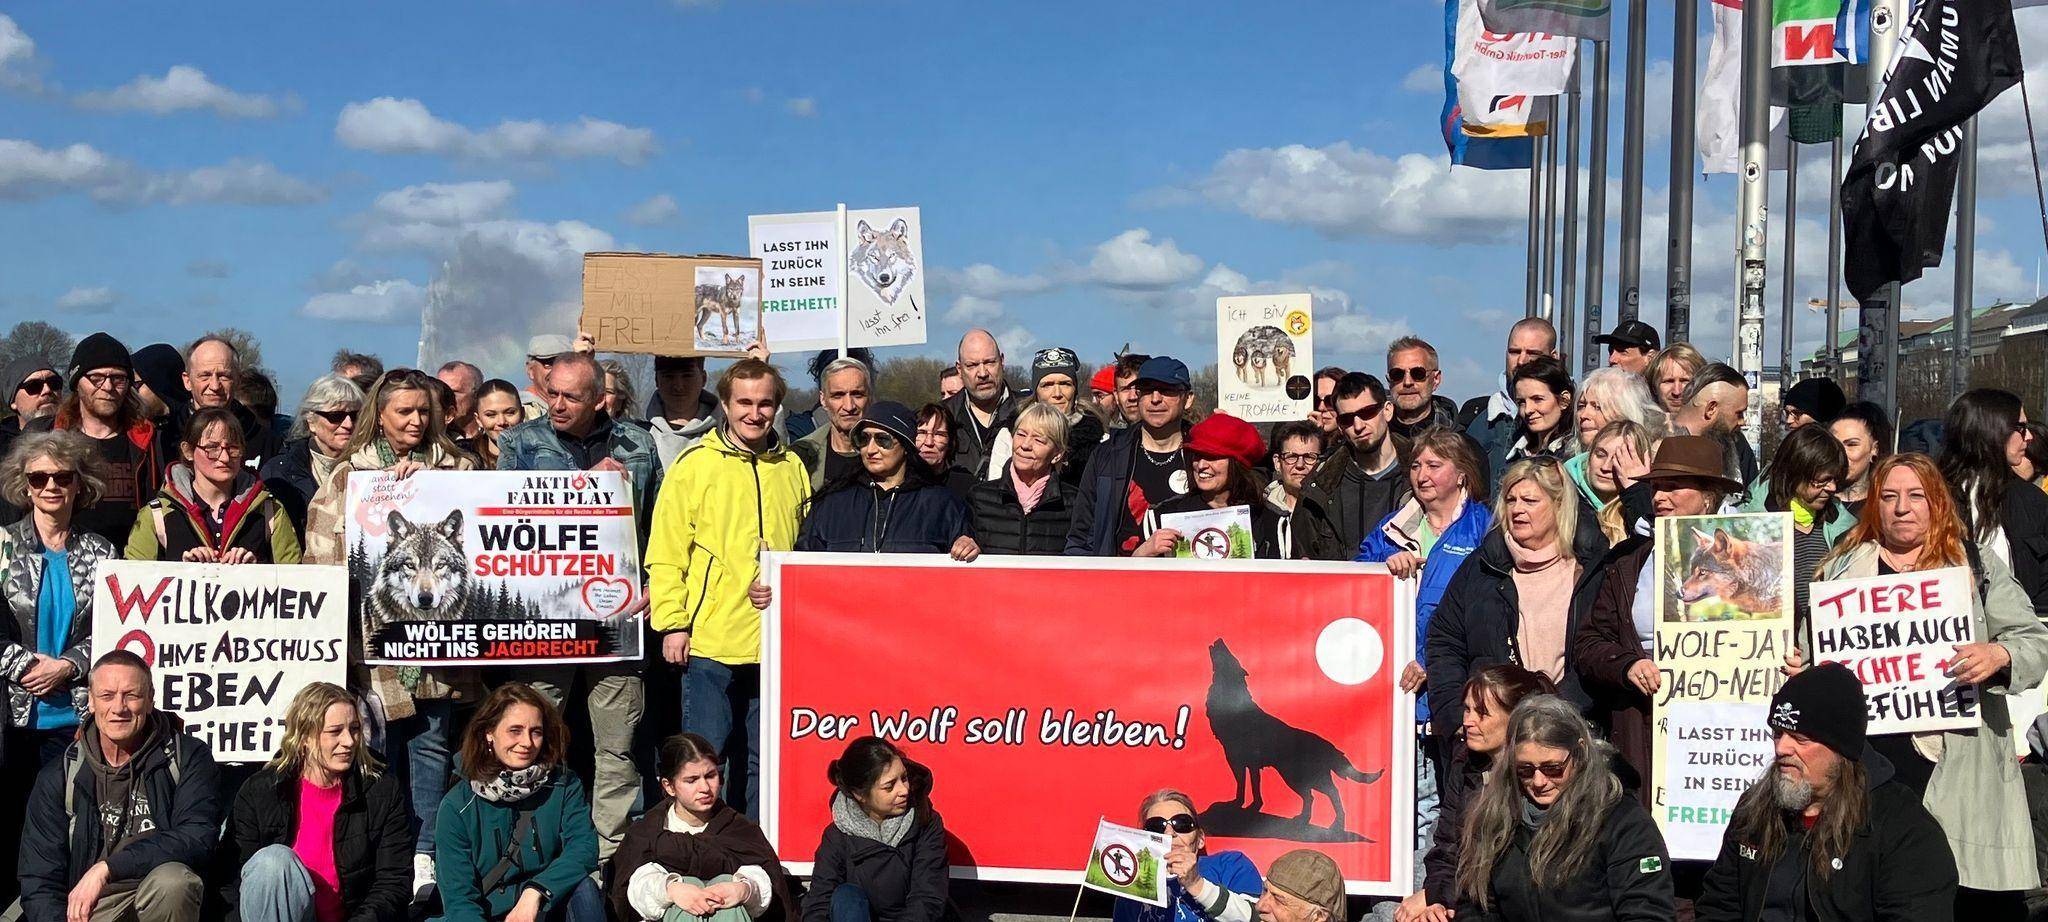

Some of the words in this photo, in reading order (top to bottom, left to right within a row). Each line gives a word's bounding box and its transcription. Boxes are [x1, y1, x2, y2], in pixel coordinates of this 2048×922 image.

[763, 240, 801, 252] LASST
[805, 240, 829, 251] IHN
[772, 256, 823, 270] ZURÜCK
[770, 278, 785, 288] IN
[789, 276, 826, 287] SEINE
[762, 297, 837, 312] FREIHEIT!
[1225, 393, 1251, 401] KEINE
[372, 484, 396, 493] statt
[507, 491, 555, 505] FAIR
[563, 491, 615, 505] PLAY
[478, 518, 599, 551] WÖLFE
[475, 551, 614, 577] SCHÜTZEN
[1818, 579, 1942, 618] TIERE
[405, 620, 477, 641] WÖLFE
[482, 619, 577, 641] GEHÖREN
[1818, 620, 1901, 653] HABEN
[1906, 615, 1971, 647] AUCH
[211, 630, 343, 664] ABSCHUSS
[384, 642, 441, 658] NICHT
[446, 642, 479, 658] INS
[484, 640, 599, 658] JAGDRECHT
[162, 671, 284, 713] EBEN
[1864, 684, 1977, 721] EFÜHLE
[790, 706, 859, 740] Der
[869, 706, 959, 745] Wolf
[964, 708, 1027, 745] soll
[1038, 704, 1192, 751] bleiben!
[1678, 727, 1734, 741] LASST
[1740, 728, 1775, 742] IHN
[1687, 748, 1765, 767] ZURÜCK
[1684, 776, 1705, 790] IN
[1711, 777, 1756, 791] SEIN
